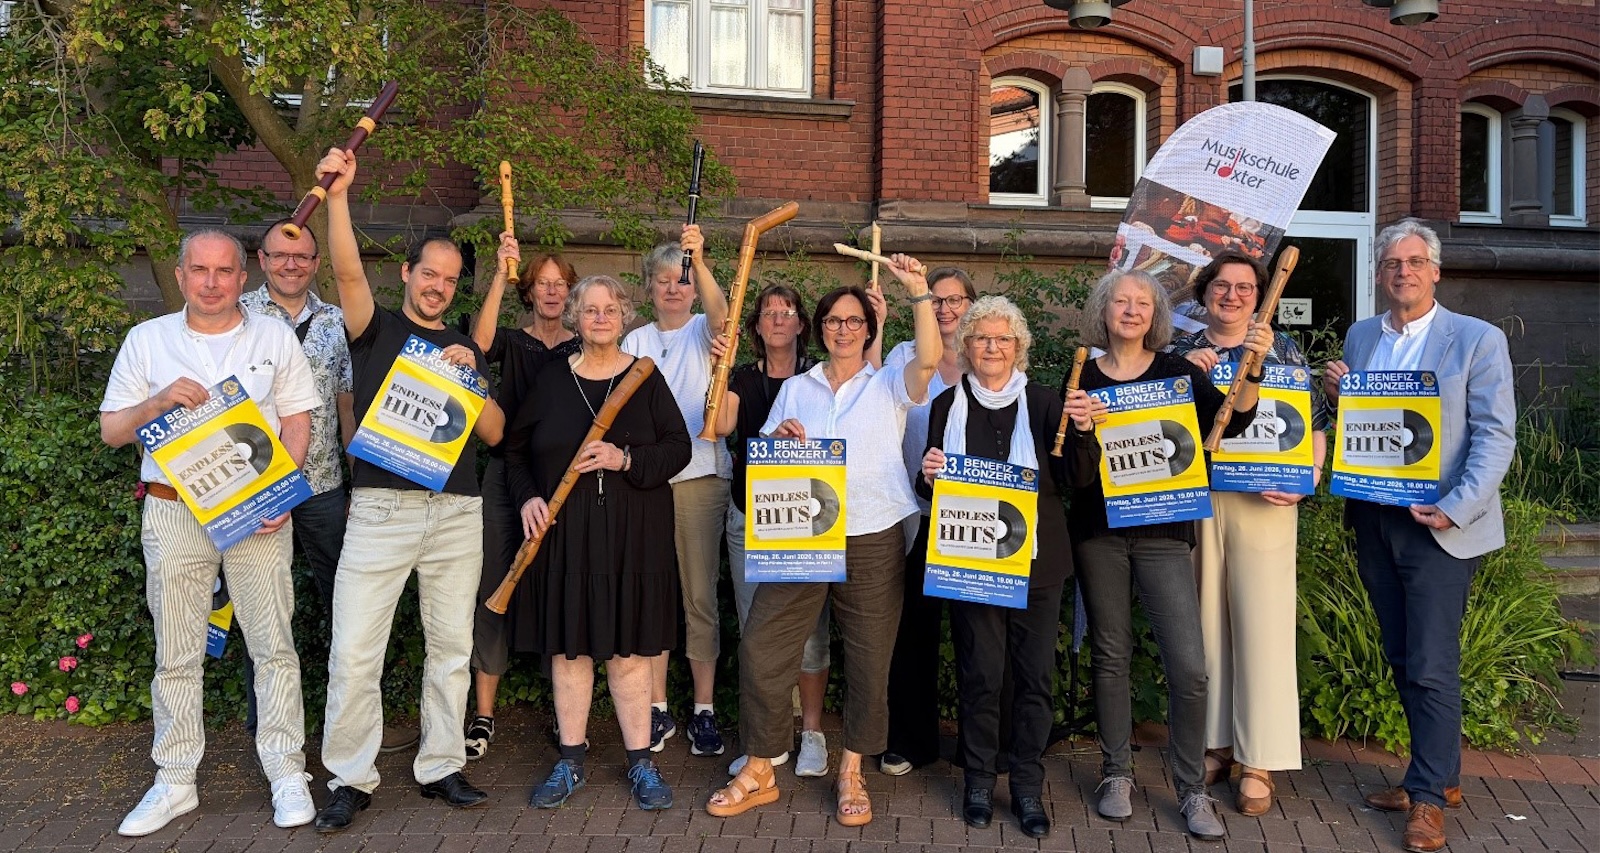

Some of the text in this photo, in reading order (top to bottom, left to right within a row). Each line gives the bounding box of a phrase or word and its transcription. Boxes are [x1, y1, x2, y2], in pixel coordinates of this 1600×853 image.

[1201, 137, 1299, 180] Musikschule
[1204, 157, 1265, 189] Höxter
[405, 339, 427, 360] 33.
[428, 355, 476, 385] KONZERT
[1367, 373, 1414, 381] BENEFIZ
[1115, 382, 1166, 396] BENEFIZ
[1262, 375, 1291, 385] ZERT
[1342, 374, 1364, 390] 33.
[1366, 382, 1420, 390] KONZERT
[390, 383, 442, 410] ENDLESS
[1117, 390, 1173, 405] KONZERT
[170, 395, 227, 433] KONZERT
[381, 393, 438, 427] HITS
[140, 422, 171, 445] 33.
[1345, 421, 1401, 431] ENDLESS
[749, 441, 772, 459] 33.
[1105, 433, 1161, 452] ENDLESS
[1345, 434, 1402, 453] HITS
[177, 440, 235, 481] ENDLESS
[774, 450, 828, 459] KONZERT
[1106, 446, 1167, 472] HITS
[963, 467, 1020, 483] KONZERT
[964, 458, 1014, 474] BENEFIZ
[185, 452, 248, 499] HITS
[1333, 474, 1357, 482] Freitag,
[243, 500, 256, 511] Juni
[288, 473, 301, 485] Uhr
[755, 491, 809, 503] ENDLESS
[1143, 495, 1158, 503] Juni
[755, 505, 811, 525] HITS
[940, 508, 996, 521] ENDLESS
[938, 523, 996, 544] HITS
[928, 567, 950, 577] Freitag,
